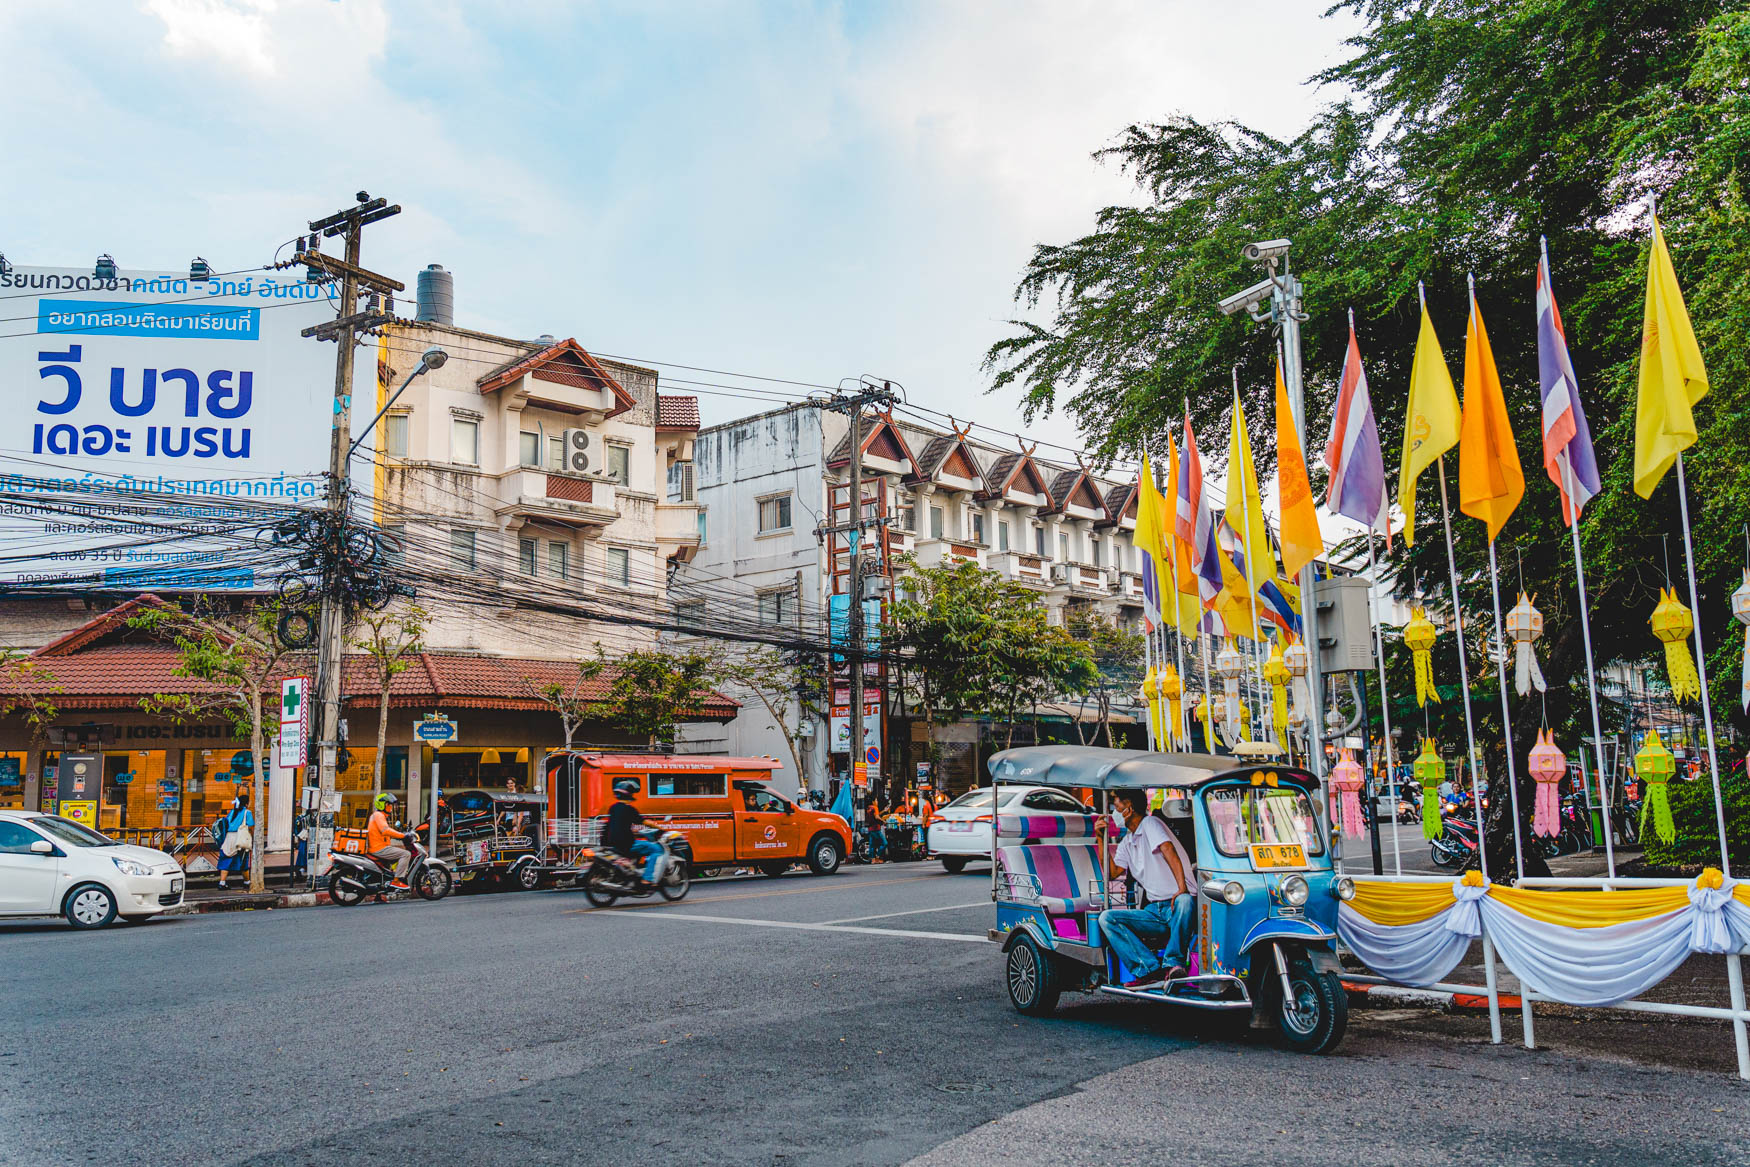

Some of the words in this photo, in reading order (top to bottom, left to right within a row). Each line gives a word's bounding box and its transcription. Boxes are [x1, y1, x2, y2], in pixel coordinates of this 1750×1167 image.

[208, 277, 253, 296] วิทย์
[258, 278, 319, 299] อันดับ
[48, 309, 252, 332] อยากสอบติดมาเรียนที่
[36, 344, 83, 416] วี
[109, 367, 254, 419] บาย
[33, 424, 132, 456] เดอะ
[147, 426, 252, 459] เบรน
[0, 471, 316, 503] ติวเตอร์ระดับประเทศมากที่สุด
[1280, 846, 1300, 858] 678
